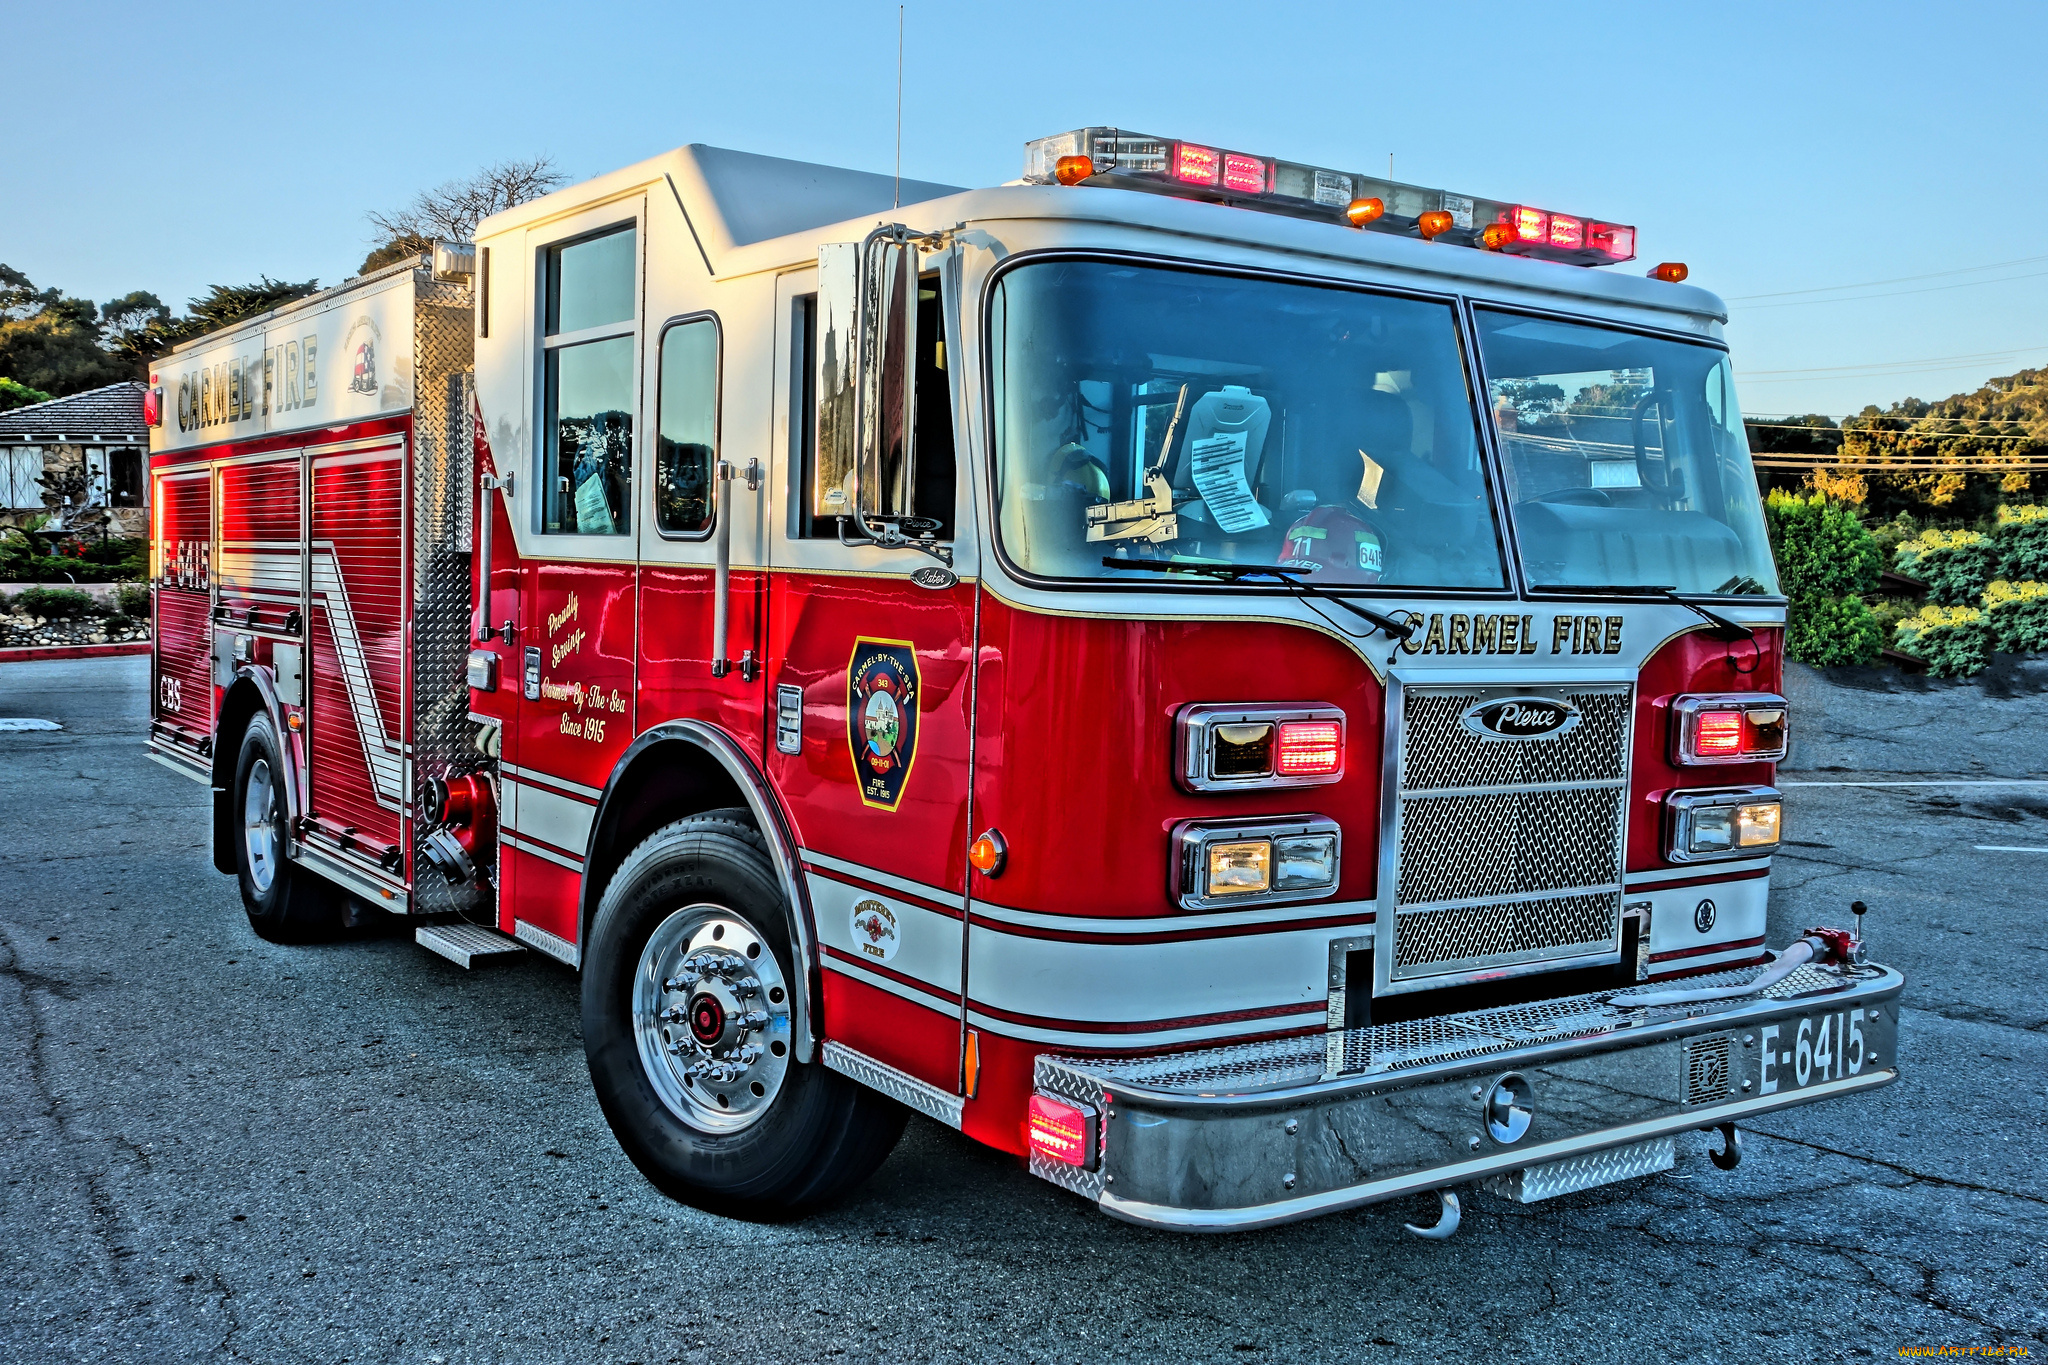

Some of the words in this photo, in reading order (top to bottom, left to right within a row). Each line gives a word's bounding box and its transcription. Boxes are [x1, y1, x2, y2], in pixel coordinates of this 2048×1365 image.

[178, 355, 253, 433] CARMEL
[261, 334, 318, 416] FIRE
[548, 590, 579, 639] Proudly
[1402, 612, 1539, 655] CARMEL
[1550, 615, 1624, 655] FIRE
[877, 679, 889, 688] 343
[560, 712, 582, 737] Since
[583, 717, 606, 743] 1915
[1496, 703, 1556, 731] Pierce
[872, 778, 886, 789] FIRE
[854, 899, 897, 929] MONTEREY
[862, 942, 885, 959] FIRE
[1760, 1008, 1865, 1096] E-6415
